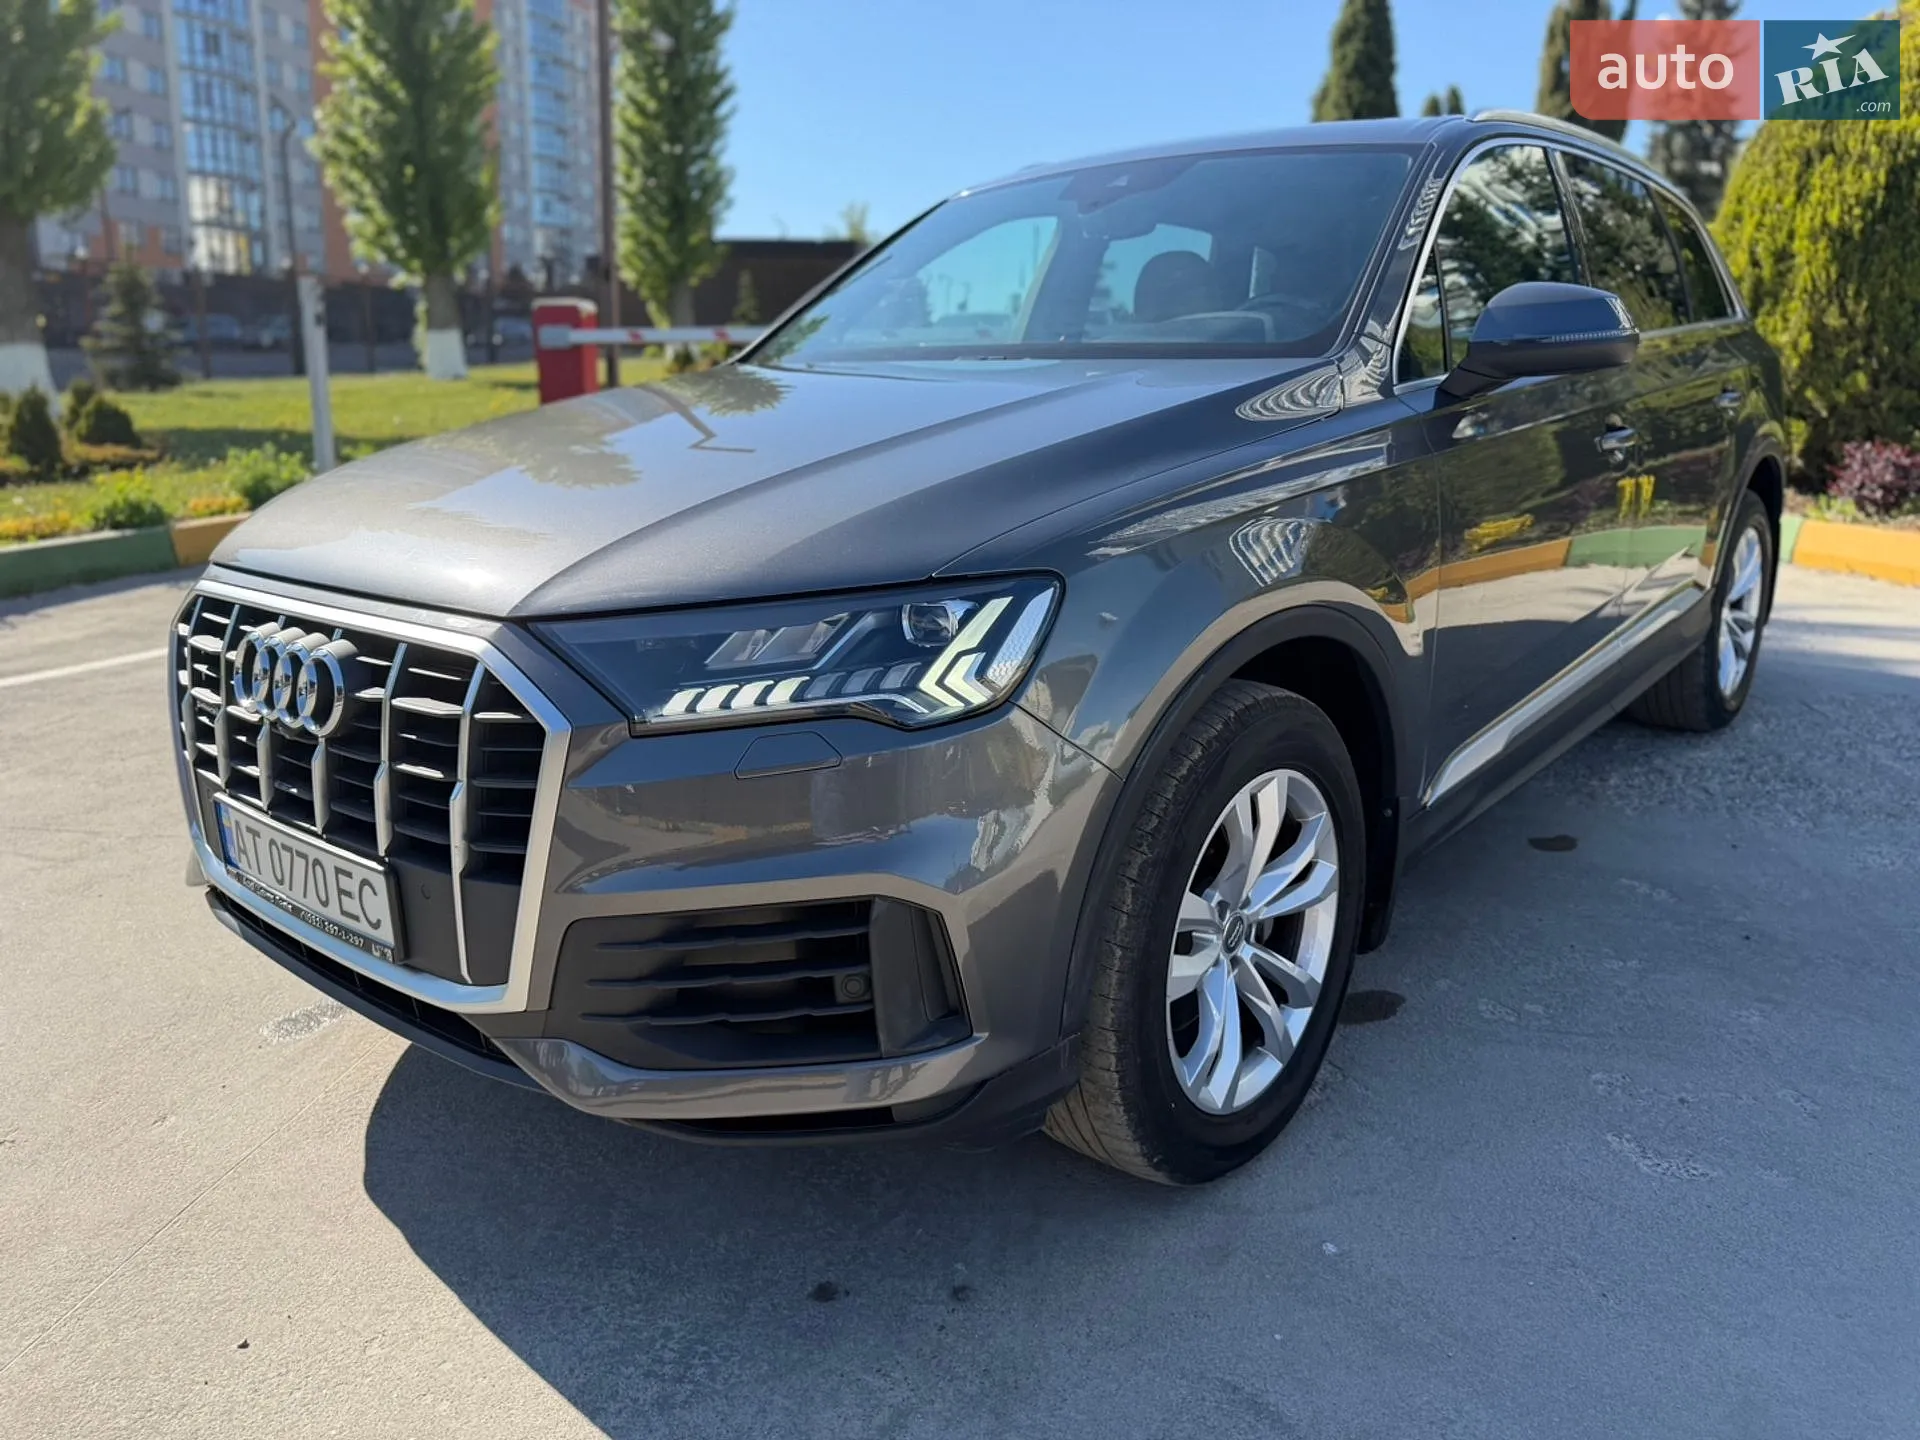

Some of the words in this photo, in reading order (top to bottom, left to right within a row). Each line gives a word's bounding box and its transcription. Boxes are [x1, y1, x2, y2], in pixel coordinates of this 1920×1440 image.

[235, 820, 262, 875] AT
[269, 838, 330, 908] 0770
[334, 865, 382, 931] EC
